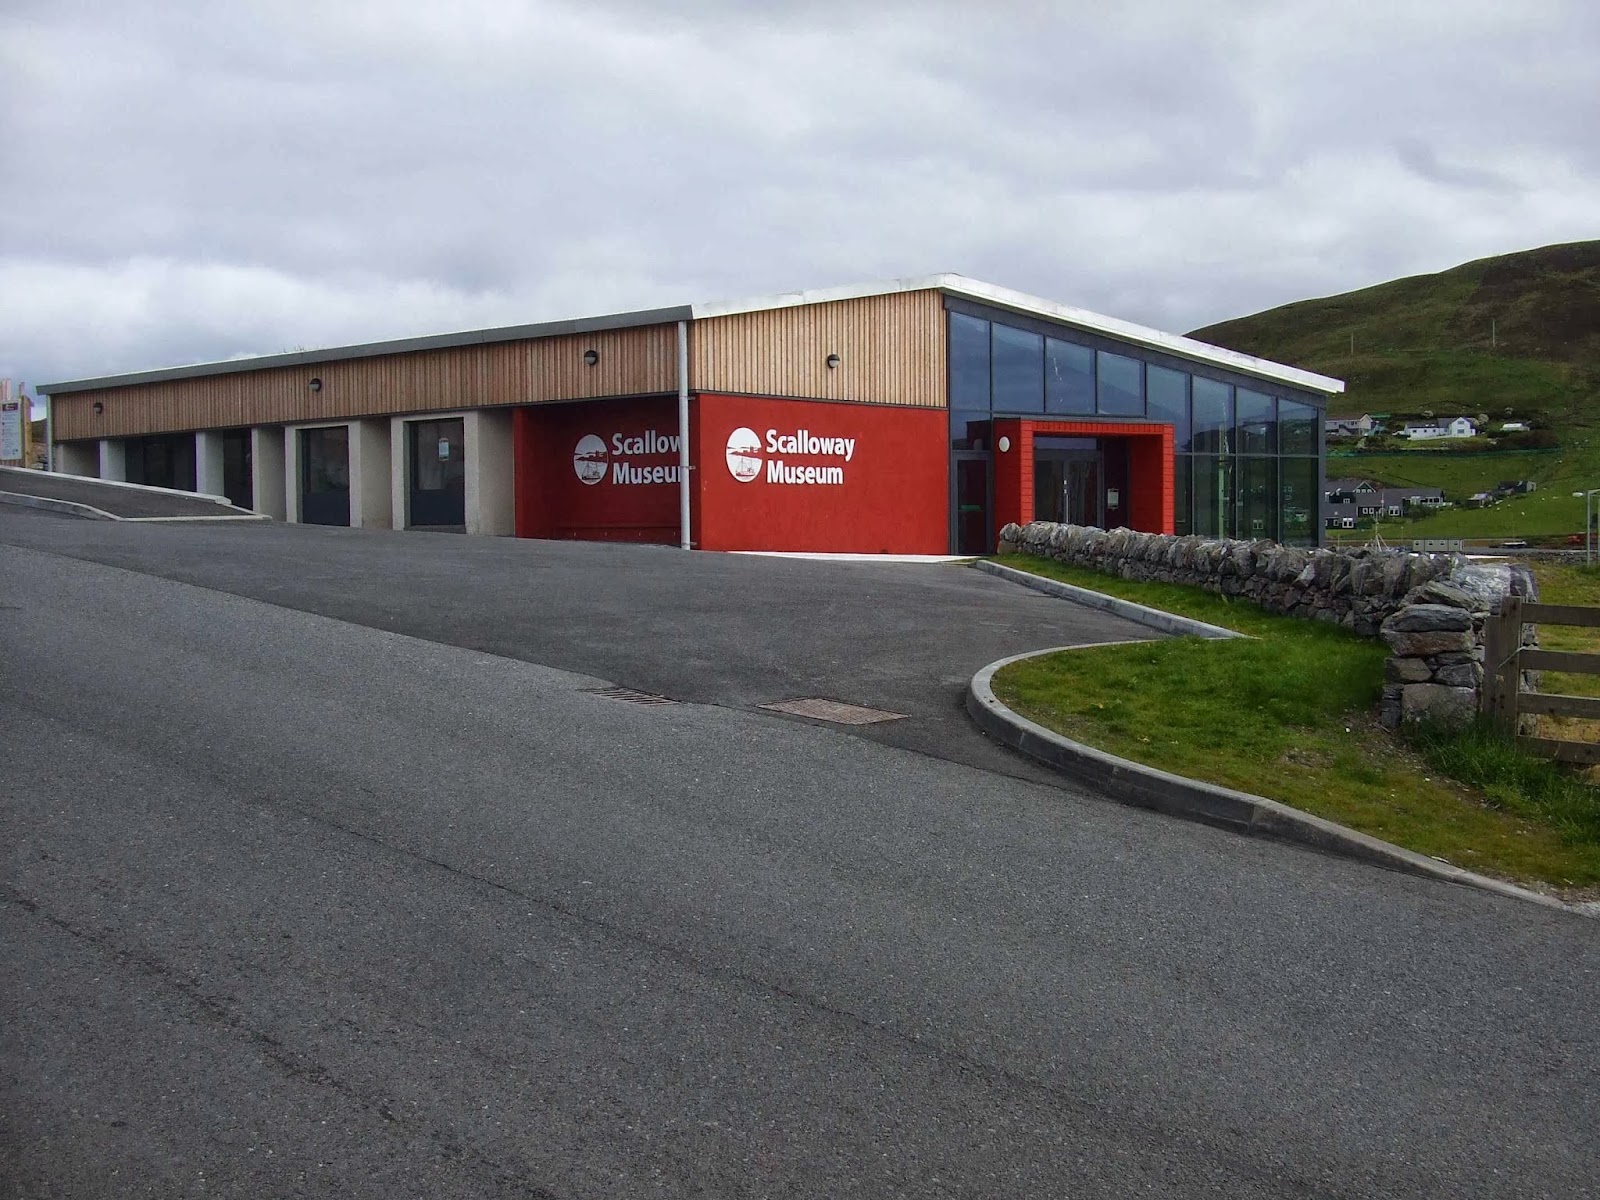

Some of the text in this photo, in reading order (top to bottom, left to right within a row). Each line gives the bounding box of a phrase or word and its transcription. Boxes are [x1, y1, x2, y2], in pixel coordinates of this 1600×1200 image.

[612, 430, 681, 456] Scallow
[766, 429, 855, 462] Scalloway
[613, 462, 682, 485] Museu
[767, 460, 843, 484] Museum
